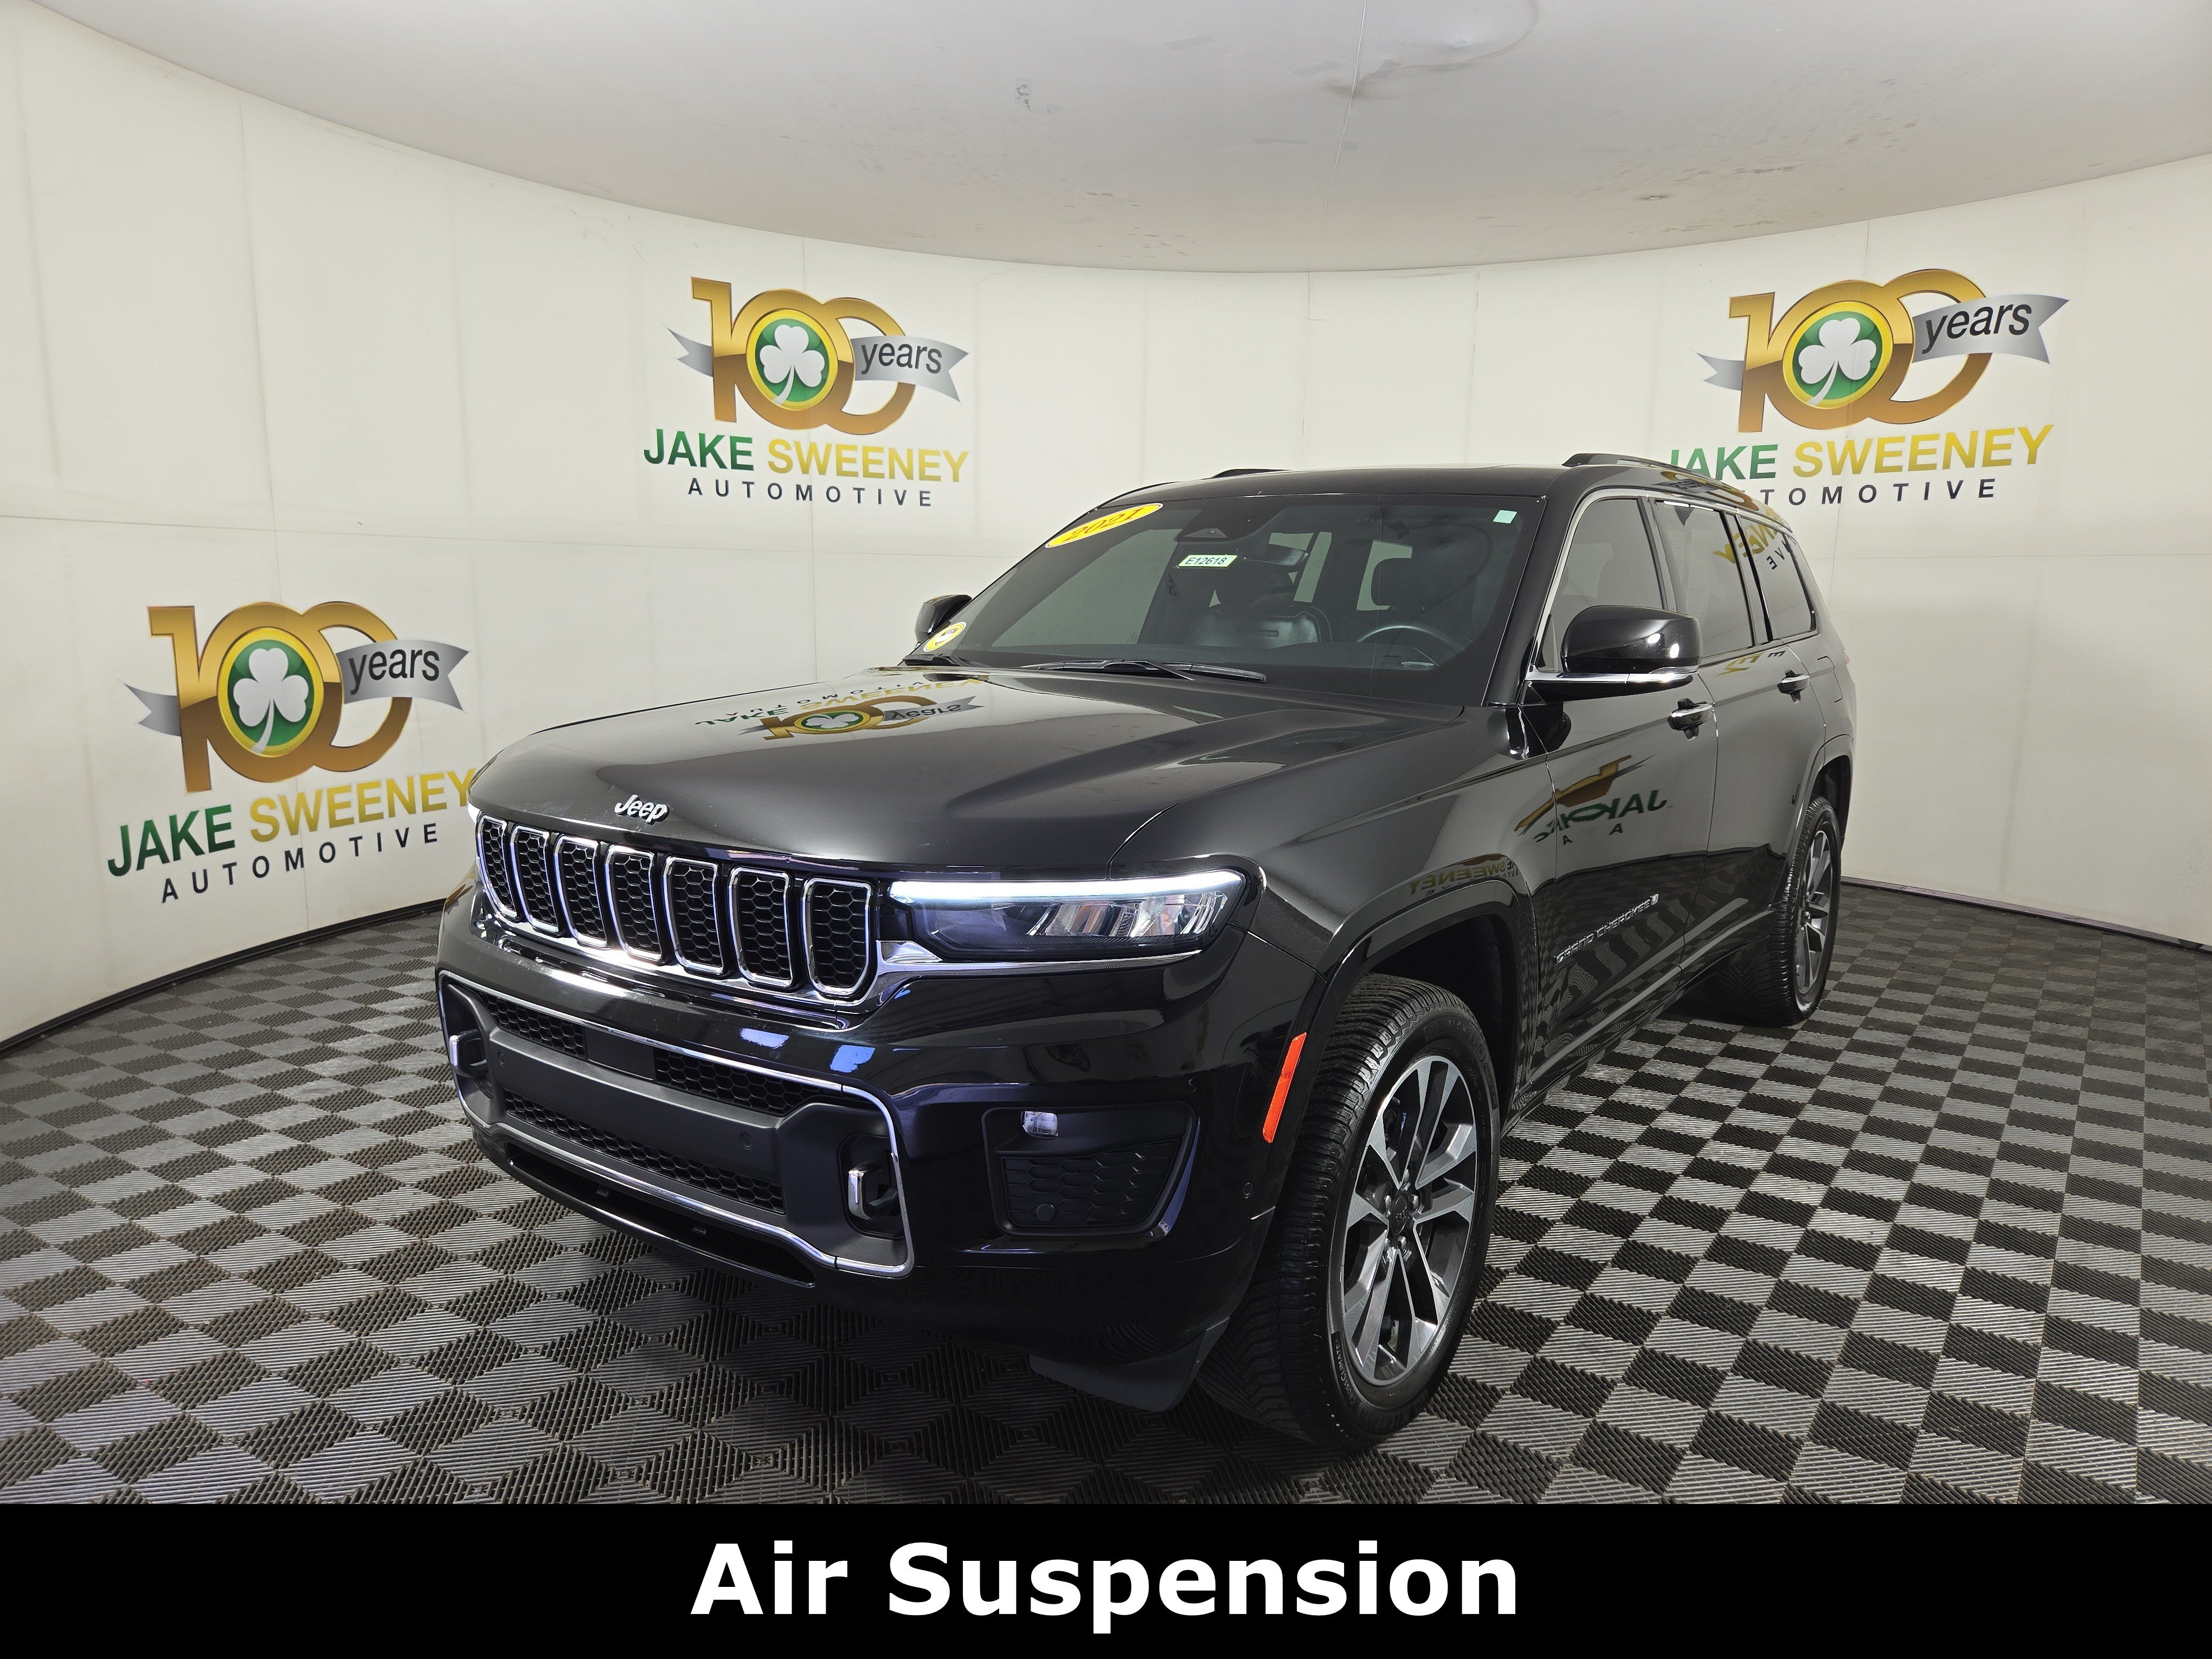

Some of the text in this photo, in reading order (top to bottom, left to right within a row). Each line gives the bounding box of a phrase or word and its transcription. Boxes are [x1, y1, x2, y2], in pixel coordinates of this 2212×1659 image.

[691, 276, 943, 435] 100 years
[1728, 268, 2033, 434] 100 years
[644, 428, 970, 483] JAKE SWEENEY
[1792, 424, 2054, 478] SWEENEY
[687, 477, 931, 507] AUTOMOTIVE
[1740, 478, 1997, 506] TOMOTIVE
[1061, 507, 1146, 543] 2021
[1184, 557, 1228, 565] E12618
[147, 601, 440, 794] 100 years
[107, 767, 477, 878] JAKE SWEENEY
[614, 794, 670, 825] Jeep
[161, 822, 438, 904] AUTOMOTIVE
[1554, 933, 1594, 964] GRAND
[1594, 898, 1651, 939] CHEROKEE
